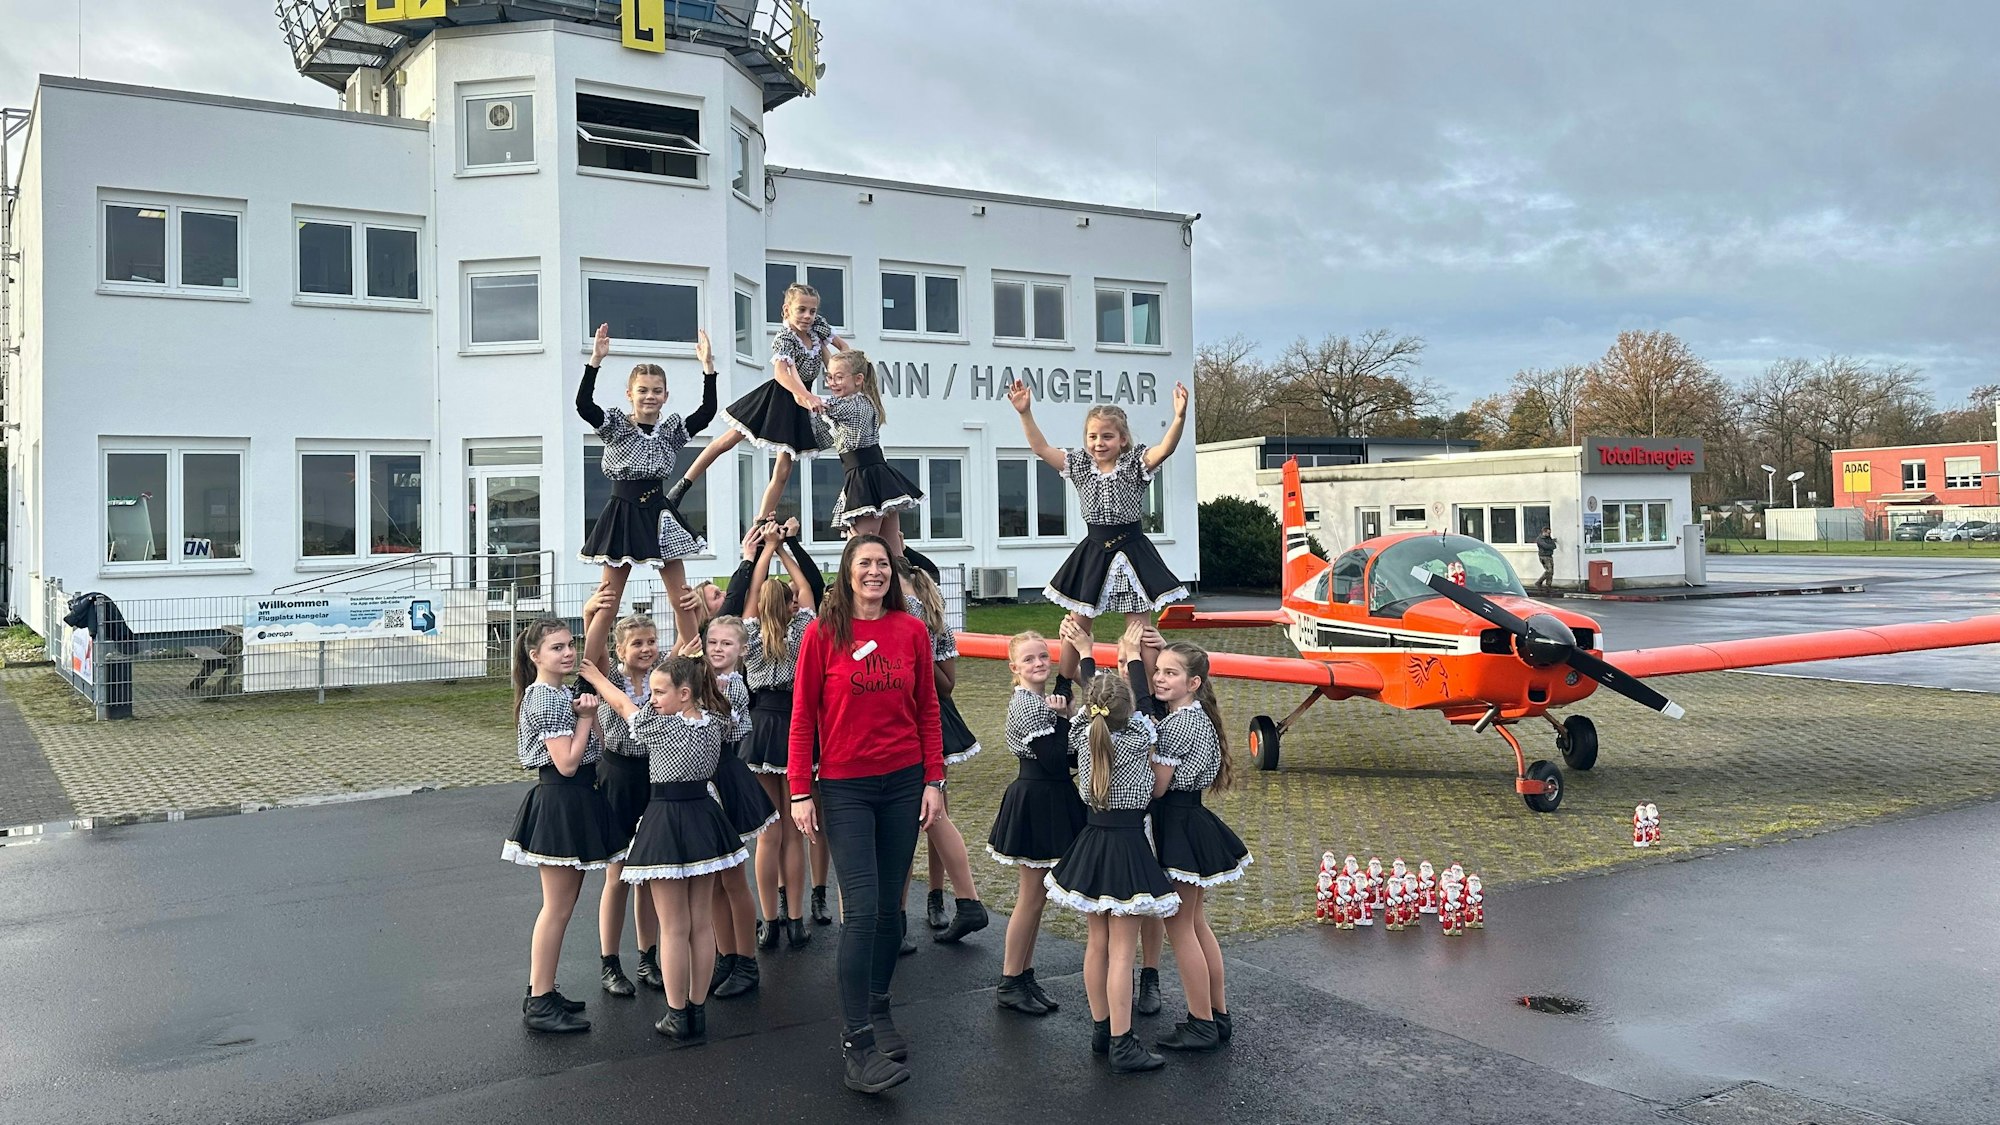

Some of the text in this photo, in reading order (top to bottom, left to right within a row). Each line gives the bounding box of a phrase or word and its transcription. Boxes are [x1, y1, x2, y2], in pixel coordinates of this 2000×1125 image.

[970, 365, 1157, 405] HANGELAR
[1598, 446, 1696, 470] TotalEnergies
[1844, 463, 1869, 474] ADAC
[258, 600, 329, 610] Willkommen
[258, 614, 294, 622] Flugplatz
[267, 631, 293, 639] aerops
[851, 671, 905, 696] Santa
